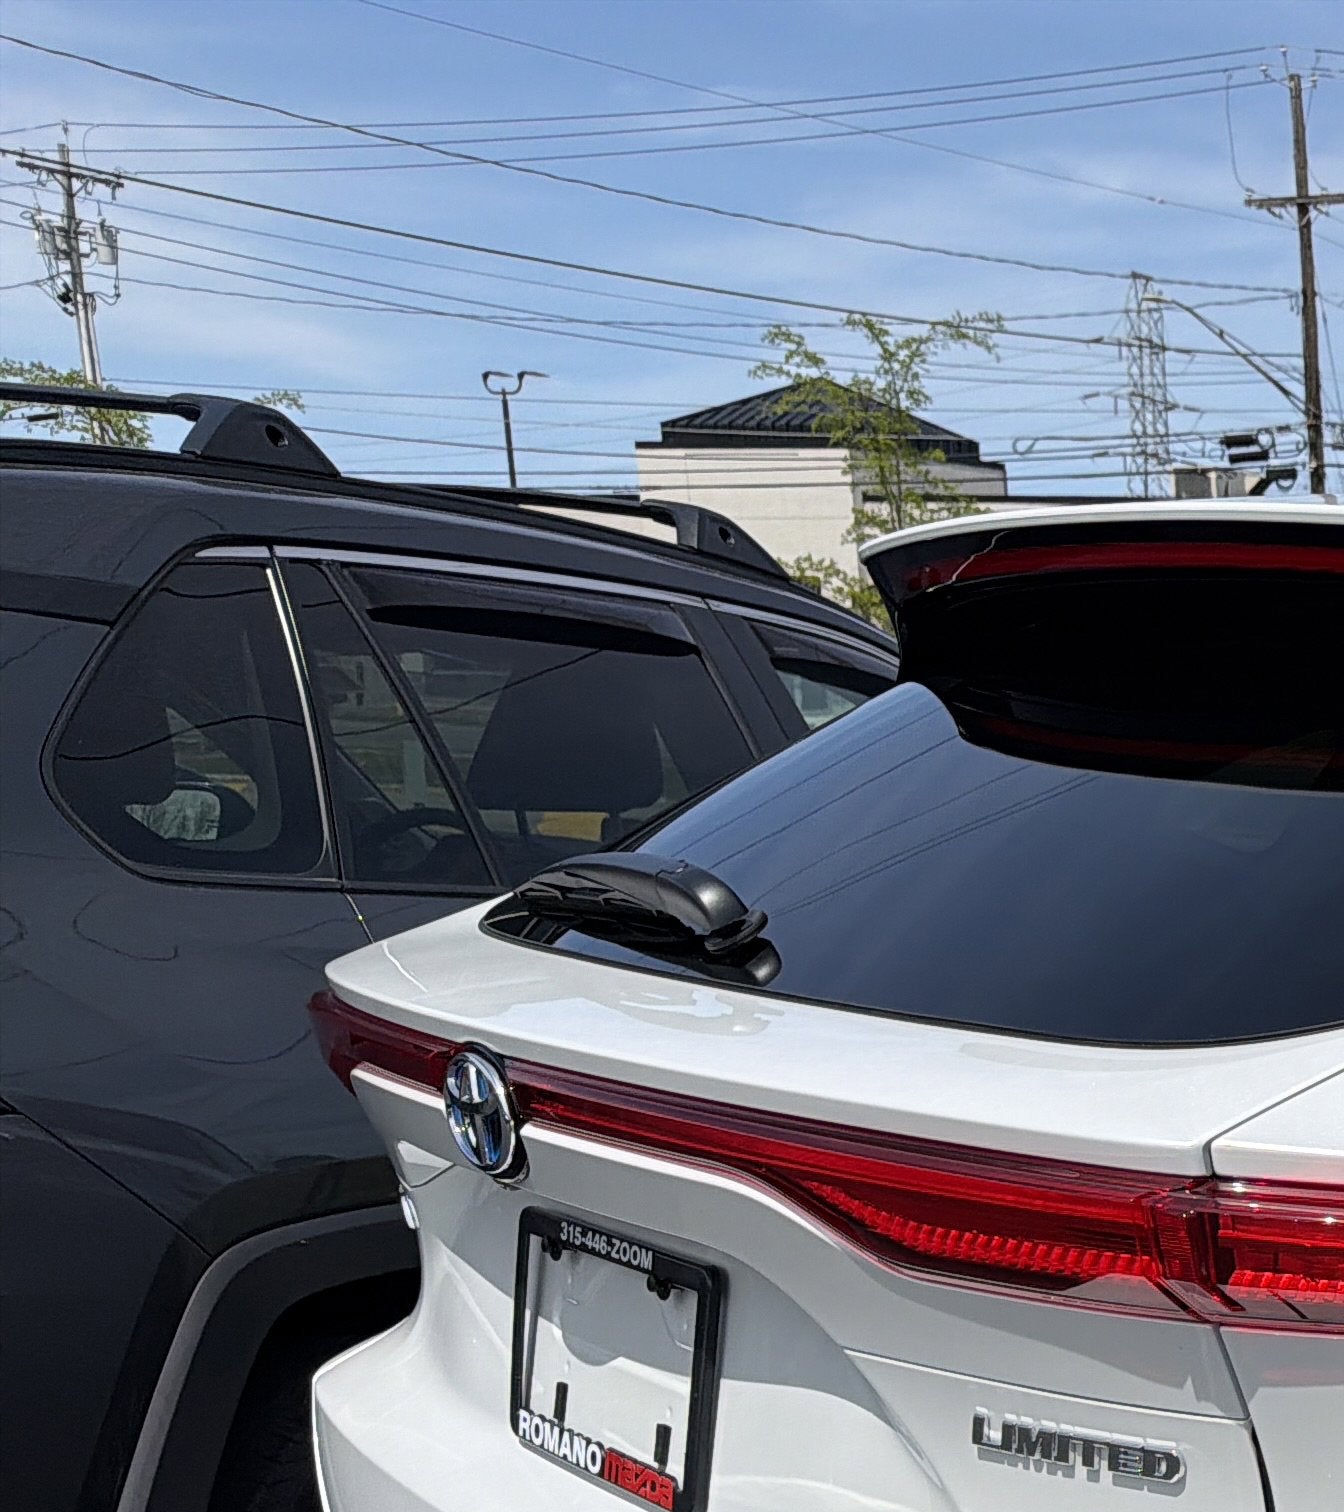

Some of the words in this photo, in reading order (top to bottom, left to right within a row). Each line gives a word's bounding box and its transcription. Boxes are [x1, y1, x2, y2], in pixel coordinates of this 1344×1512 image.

[559, 1221, 654, 1271] 315-446-ZOOM
[518, 1408, 602, 1475] ROMANO
[603, 1450, 675, 1511] mazda
[971, 1406, 1188, 1484] LIMITED
